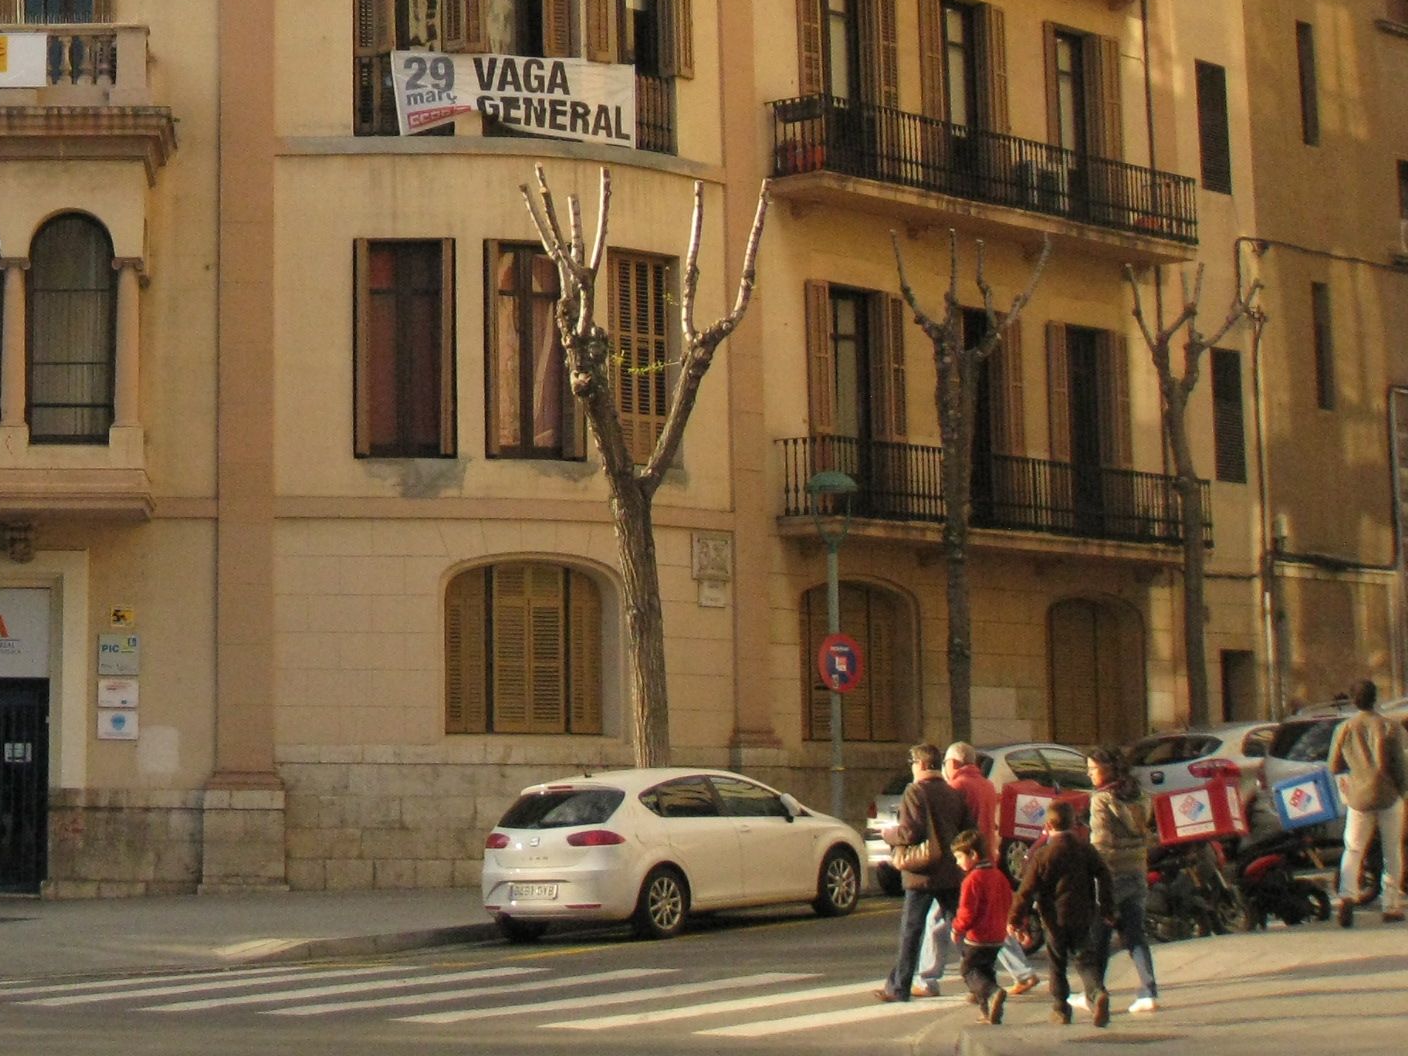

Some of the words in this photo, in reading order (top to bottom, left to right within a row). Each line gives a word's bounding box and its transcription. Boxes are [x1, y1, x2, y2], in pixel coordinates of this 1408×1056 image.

[403, 56, 455, 93] 29
[473, 56, 571, 96] VAGA
[406, 89, 458, 106] març
[476, 94, 631, 141] GENERAL
[101, 644, 120, 653] PIC
